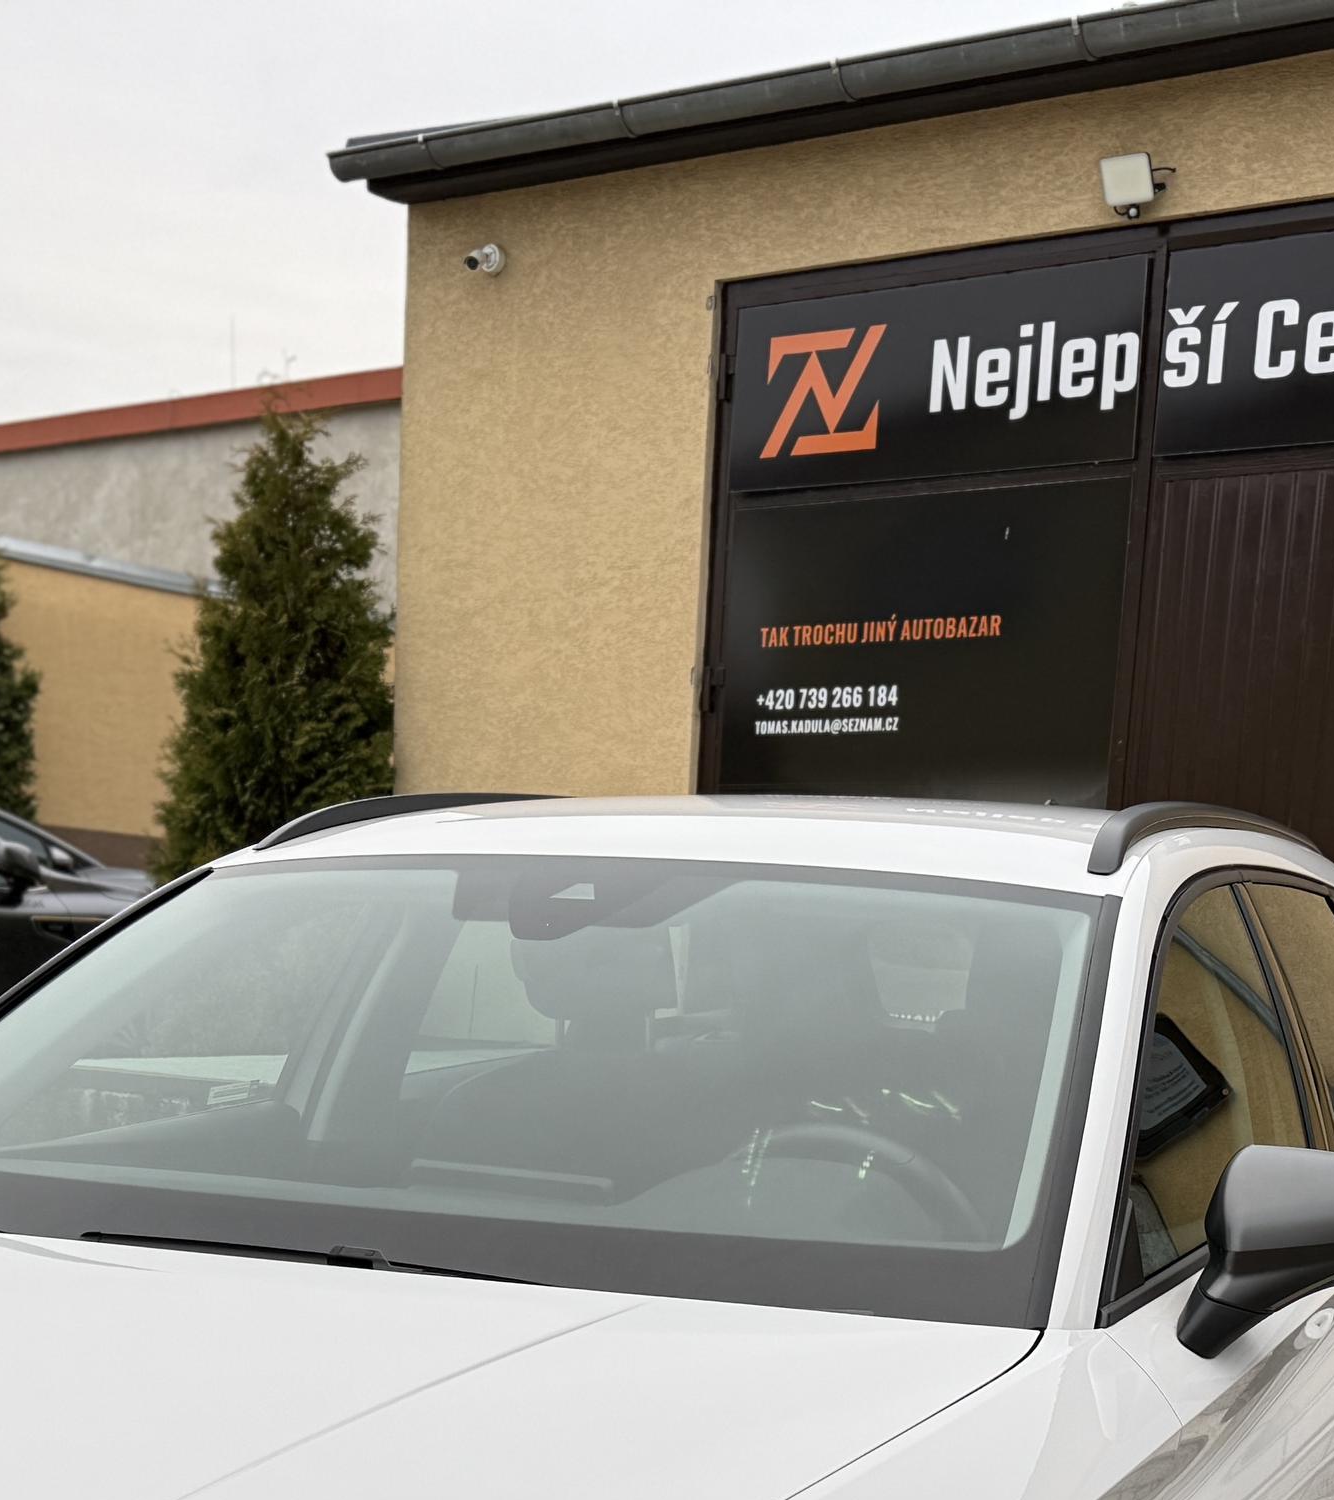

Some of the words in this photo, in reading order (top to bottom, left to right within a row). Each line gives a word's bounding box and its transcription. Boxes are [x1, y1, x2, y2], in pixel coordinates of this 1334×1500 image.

[760, 626, 788, 649] TAK
[793, 622, 859, 647] TROCHU
[861, 613, 898, 643] JINÝ
[900, 614, 1003, 641] AUTOBAZAR
[756, 688, 795, 711] +420
[799, 687, 828, 710] 739
[831, 685, 863, 709] 266
[867, 684, 898, 707] 184
[755, 716, 899, 736] TOMAS.KADULA@SEZNAM.CZ
